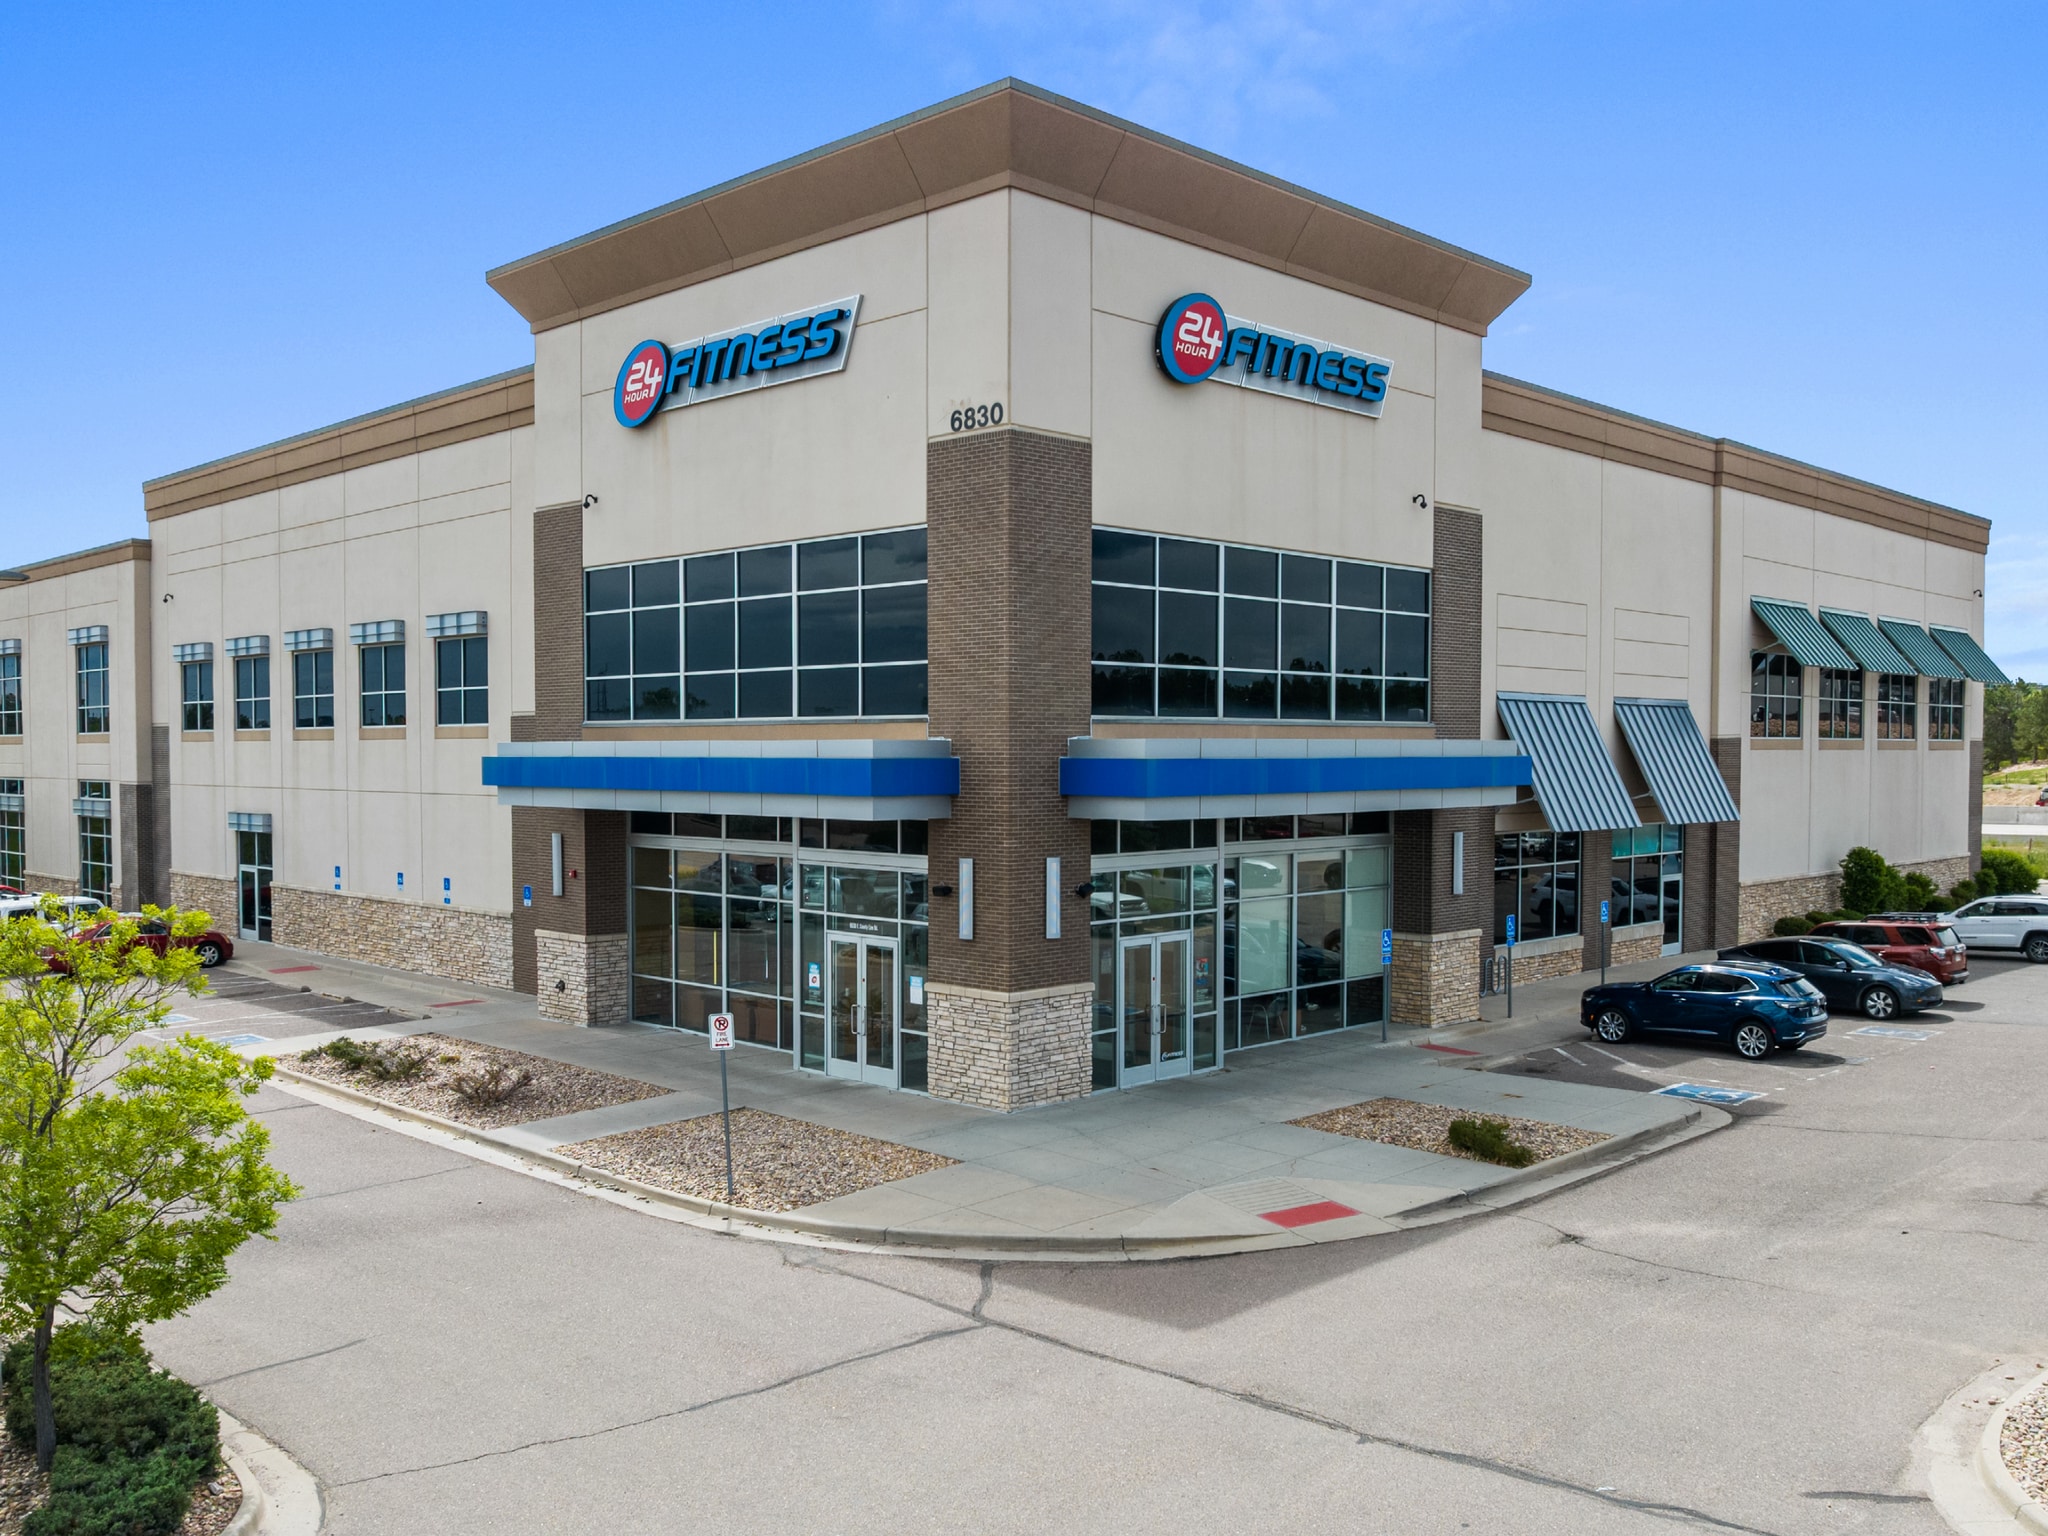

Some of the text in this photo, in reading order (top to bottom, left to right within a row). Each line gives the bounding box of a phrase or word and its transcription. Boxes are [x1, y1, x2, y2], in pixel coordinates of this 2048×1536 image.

[665, 308, 844, 394] FITNESS
[1176, 341, 1208, 358] HOUR
[1179, 311, 1223, 360] 24
[626, 359, 662, 397] 24
[1224, 327, 1389, 402] FITNESS
[624, 389, 649, 404] HOUR
[950, 402, 1004, 432] 6830
